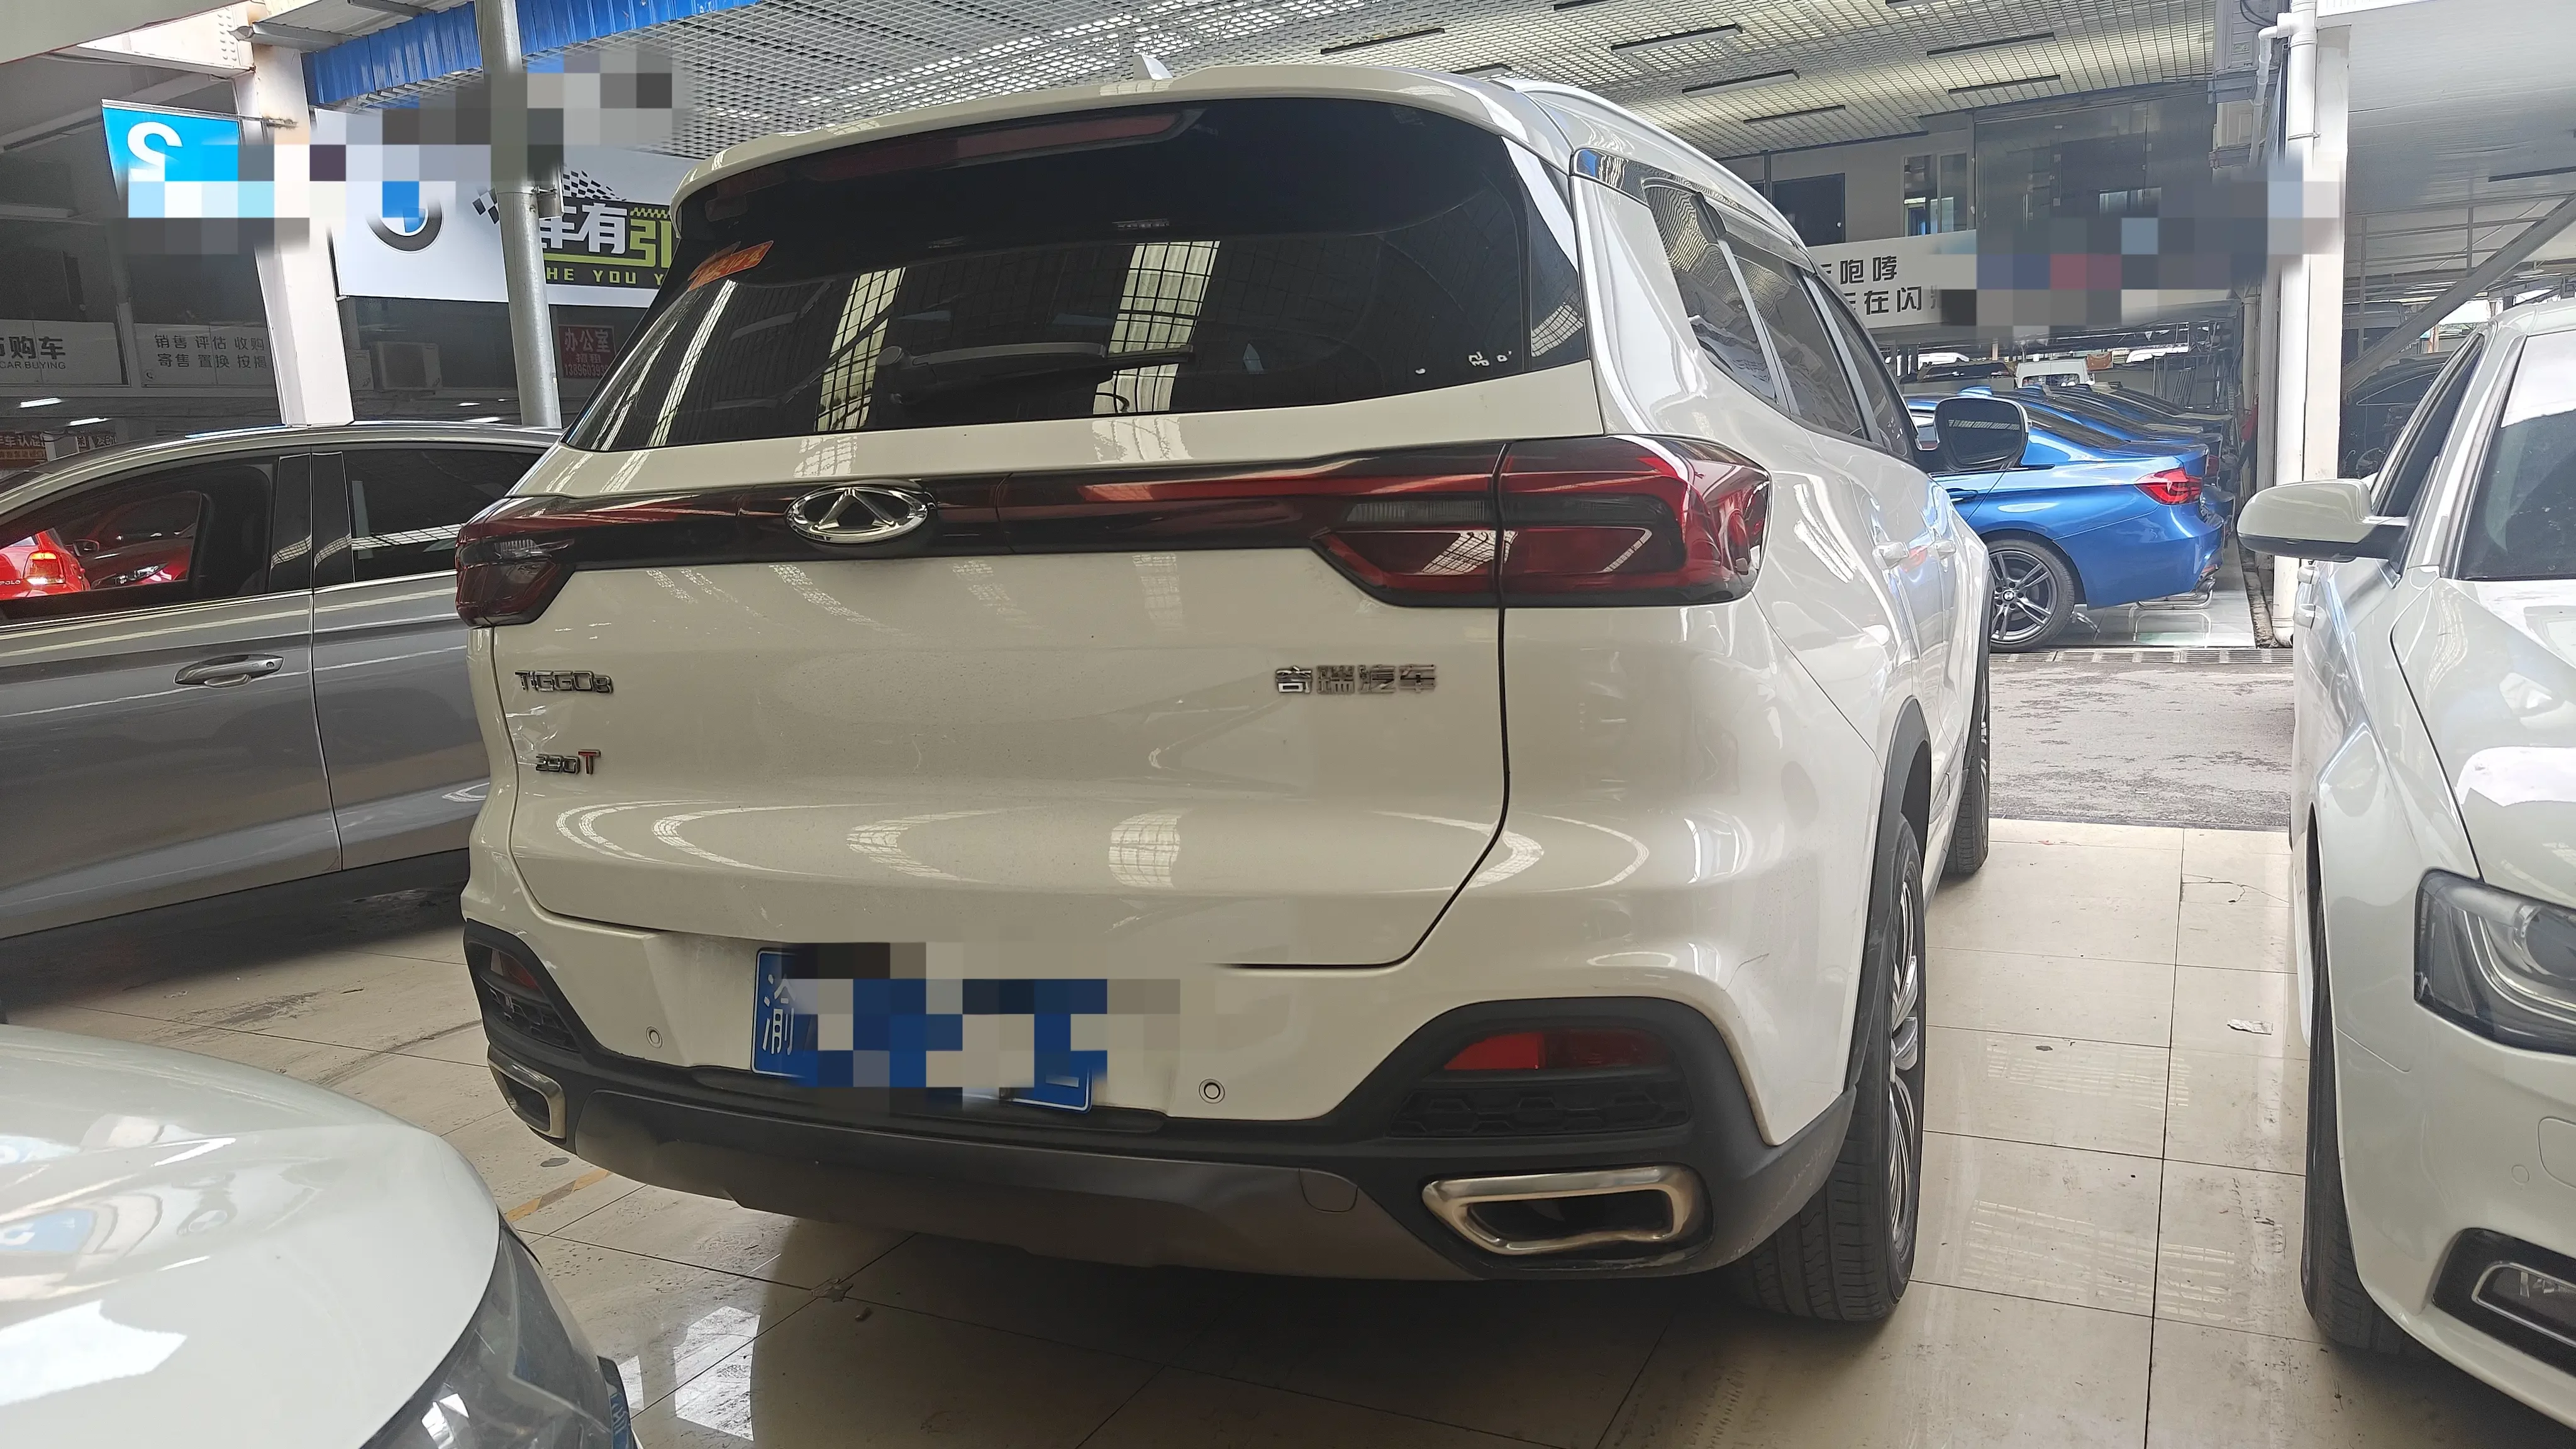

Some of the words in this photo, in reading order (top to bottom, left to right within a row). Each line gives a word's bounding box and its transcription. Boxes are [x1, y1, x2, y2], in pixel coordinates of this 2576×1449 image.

[593, 269, 636, 284] YOU
[0, 336, 66, 360] 购车
[154, 335, 187, 348] 销售
[194, 335, 226, 350] 评估
[234, 336, 265, 351] 收购
[565, 328, 610, 352] 办公室
[25, 362, 66, 370] BUYING
[157, 353, 189, 367] 寄售
[198, 354, 230, 368] 置换
[1275, 664, 1436, 694] 奇瑞汽车
